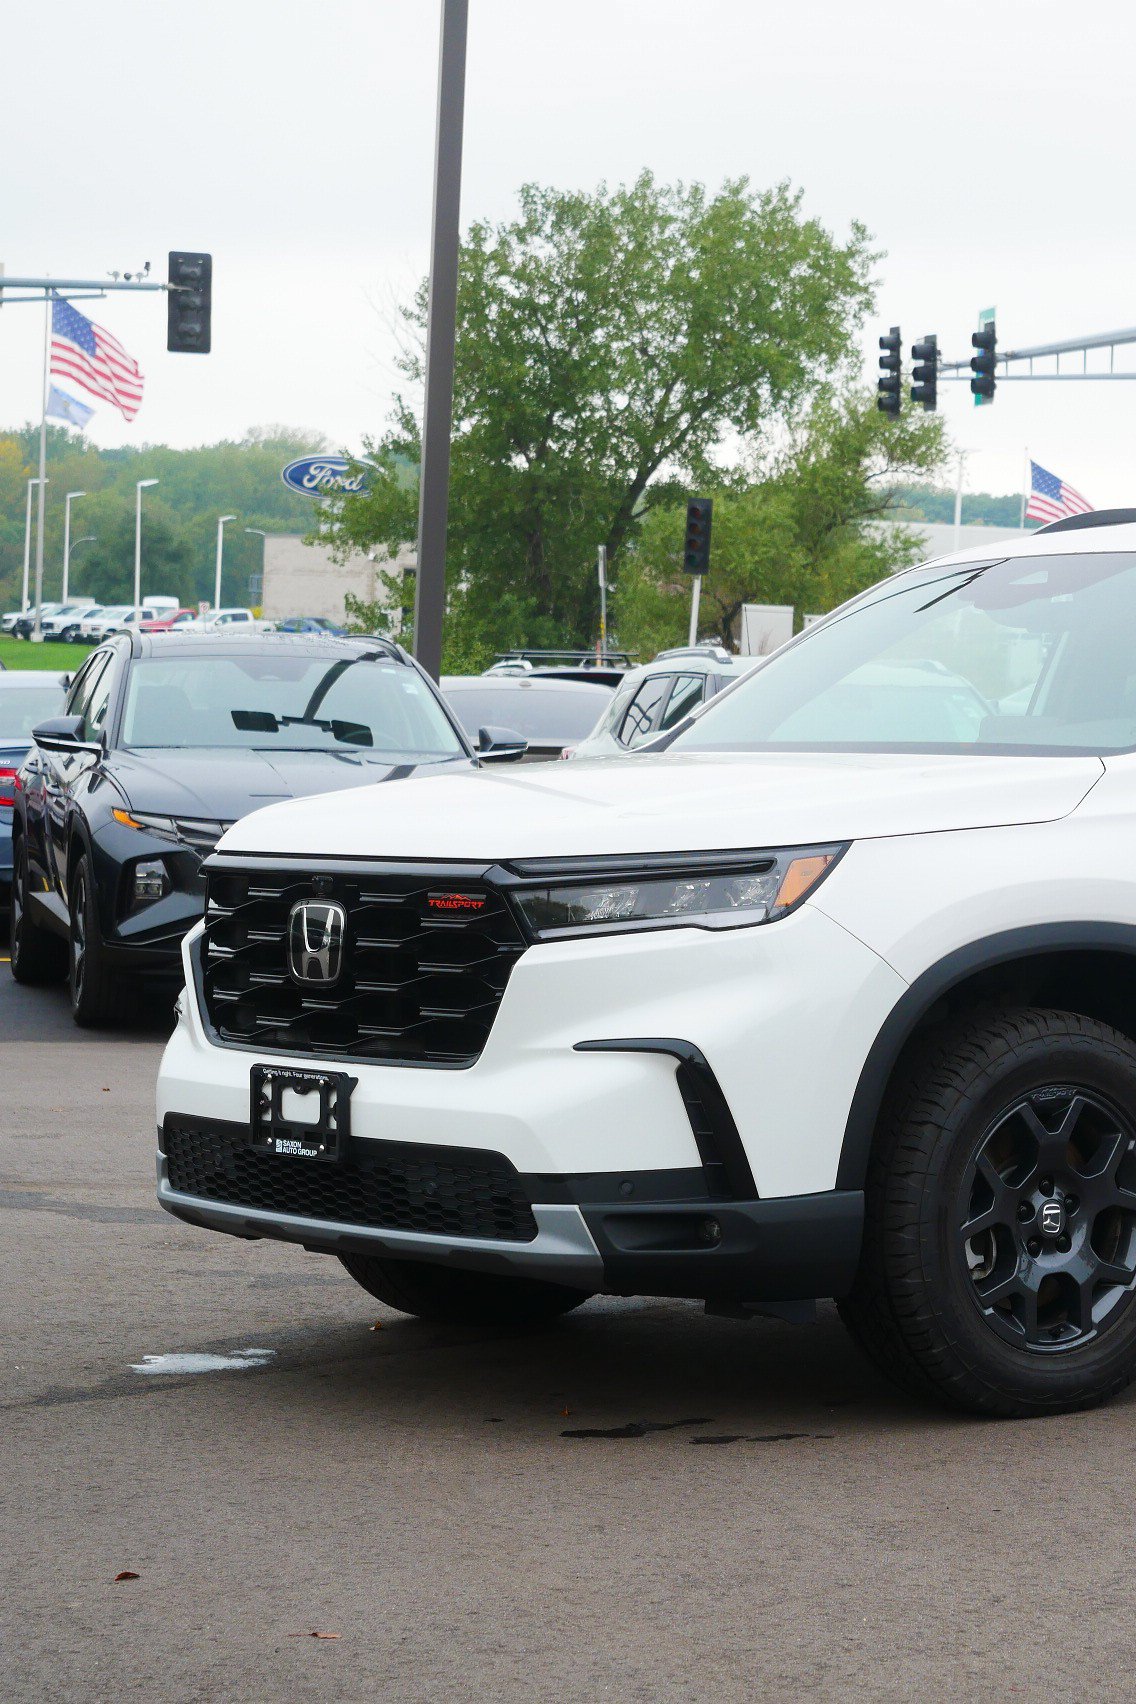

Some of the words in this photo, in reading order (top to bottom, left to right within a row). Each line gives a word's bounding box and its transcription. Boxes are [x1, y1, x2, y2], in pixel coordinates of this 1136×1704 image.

[303, 463, 365, 490] Ford
[428, 899, 484, 909] TRAILSPORT
[283, 1140, 302, 1148] SAXON
